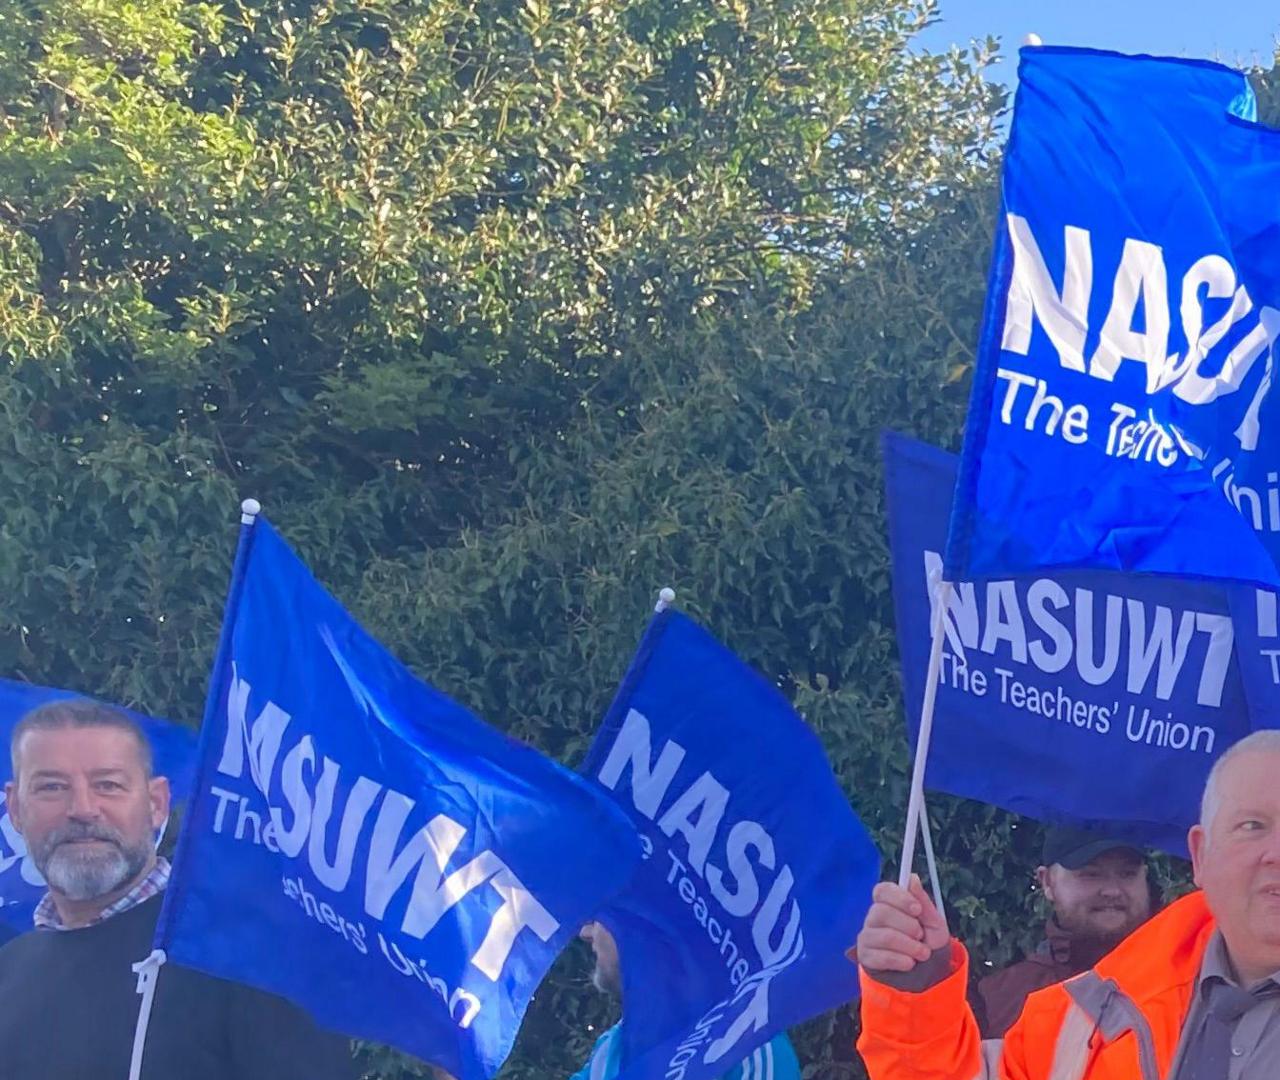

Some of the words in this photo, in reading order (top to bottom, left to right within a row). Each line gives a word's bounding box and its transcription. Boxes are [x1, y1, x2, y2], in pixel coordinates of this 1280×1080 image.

[997, 367, 1089, 445] The
[924, 550, 1234, 707] NASUWT
[937, 652, 988, 697] The
[994, 667, 1119, 735] Teachers'
[1126, 706, 1216, 754] Union
[211, 786, 282, 854] The
